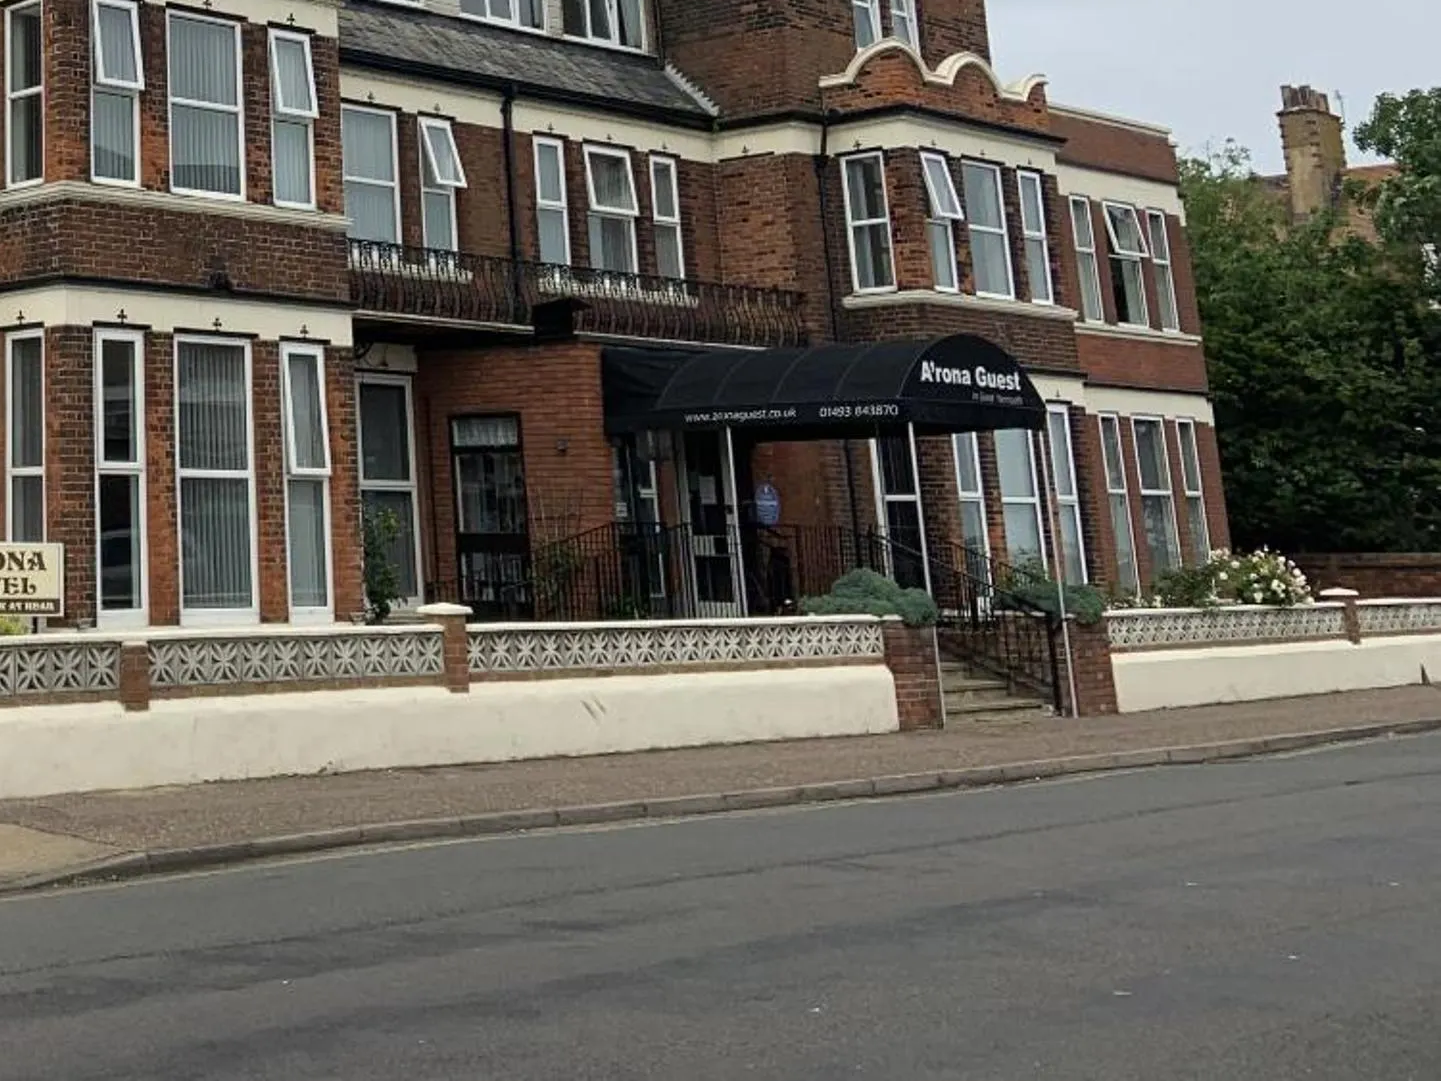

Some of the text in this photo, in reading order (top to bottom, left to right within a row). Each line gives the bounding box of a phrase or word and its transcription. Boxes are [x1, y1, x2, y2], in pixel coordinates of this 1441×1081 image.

[921, 360, 1021, 391] A'rona Guest
[819, 406, 852, 417] 01493
[8, 601, 24, 611] AT
